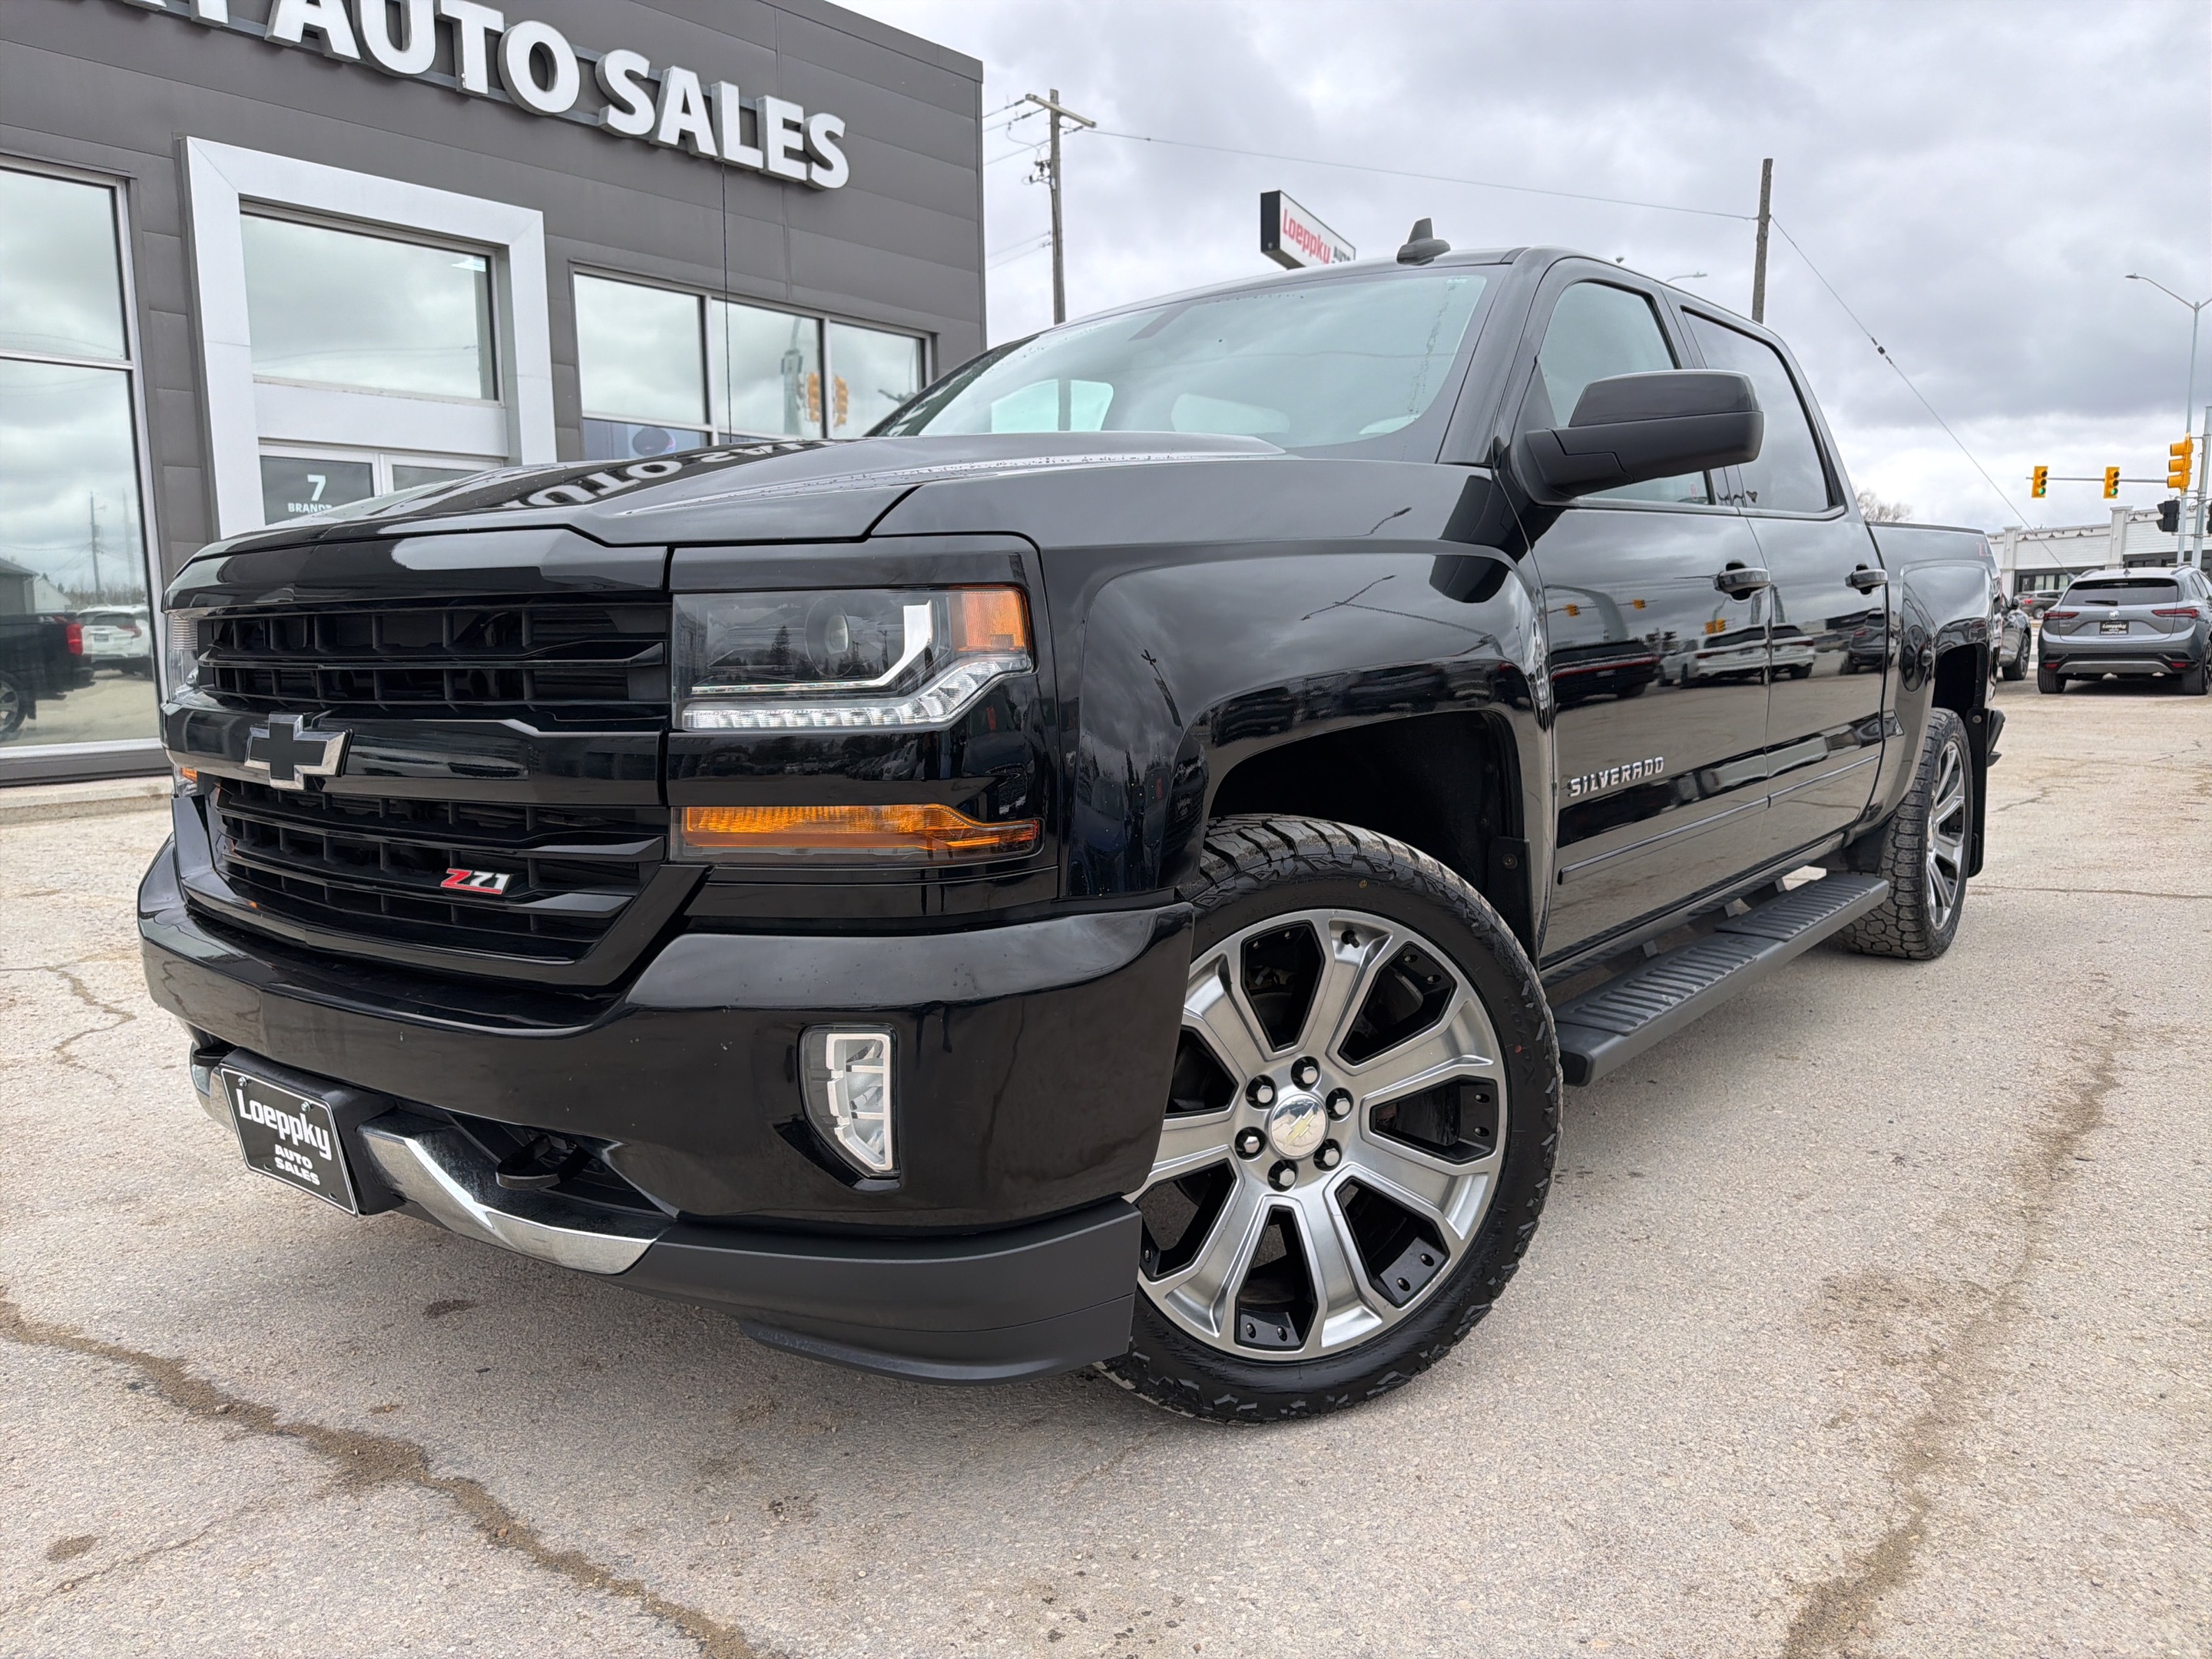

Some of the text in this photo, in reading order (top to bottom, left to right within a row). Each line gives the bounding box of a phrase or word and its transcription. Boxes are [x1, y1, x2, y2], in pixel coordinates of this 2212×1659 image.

[265, 0, 851, 190] AUTO SALES
[307, 473, 326, 502] 7
[1568, 756, 1664, 797] SILVERADO
[440, 868, 511, 895] Z71
[235, 1088, 333, 1161] Loeppky
[274, 1144, 313, 1170] AUTO
[274, 1157, 320, 1186] SALES
